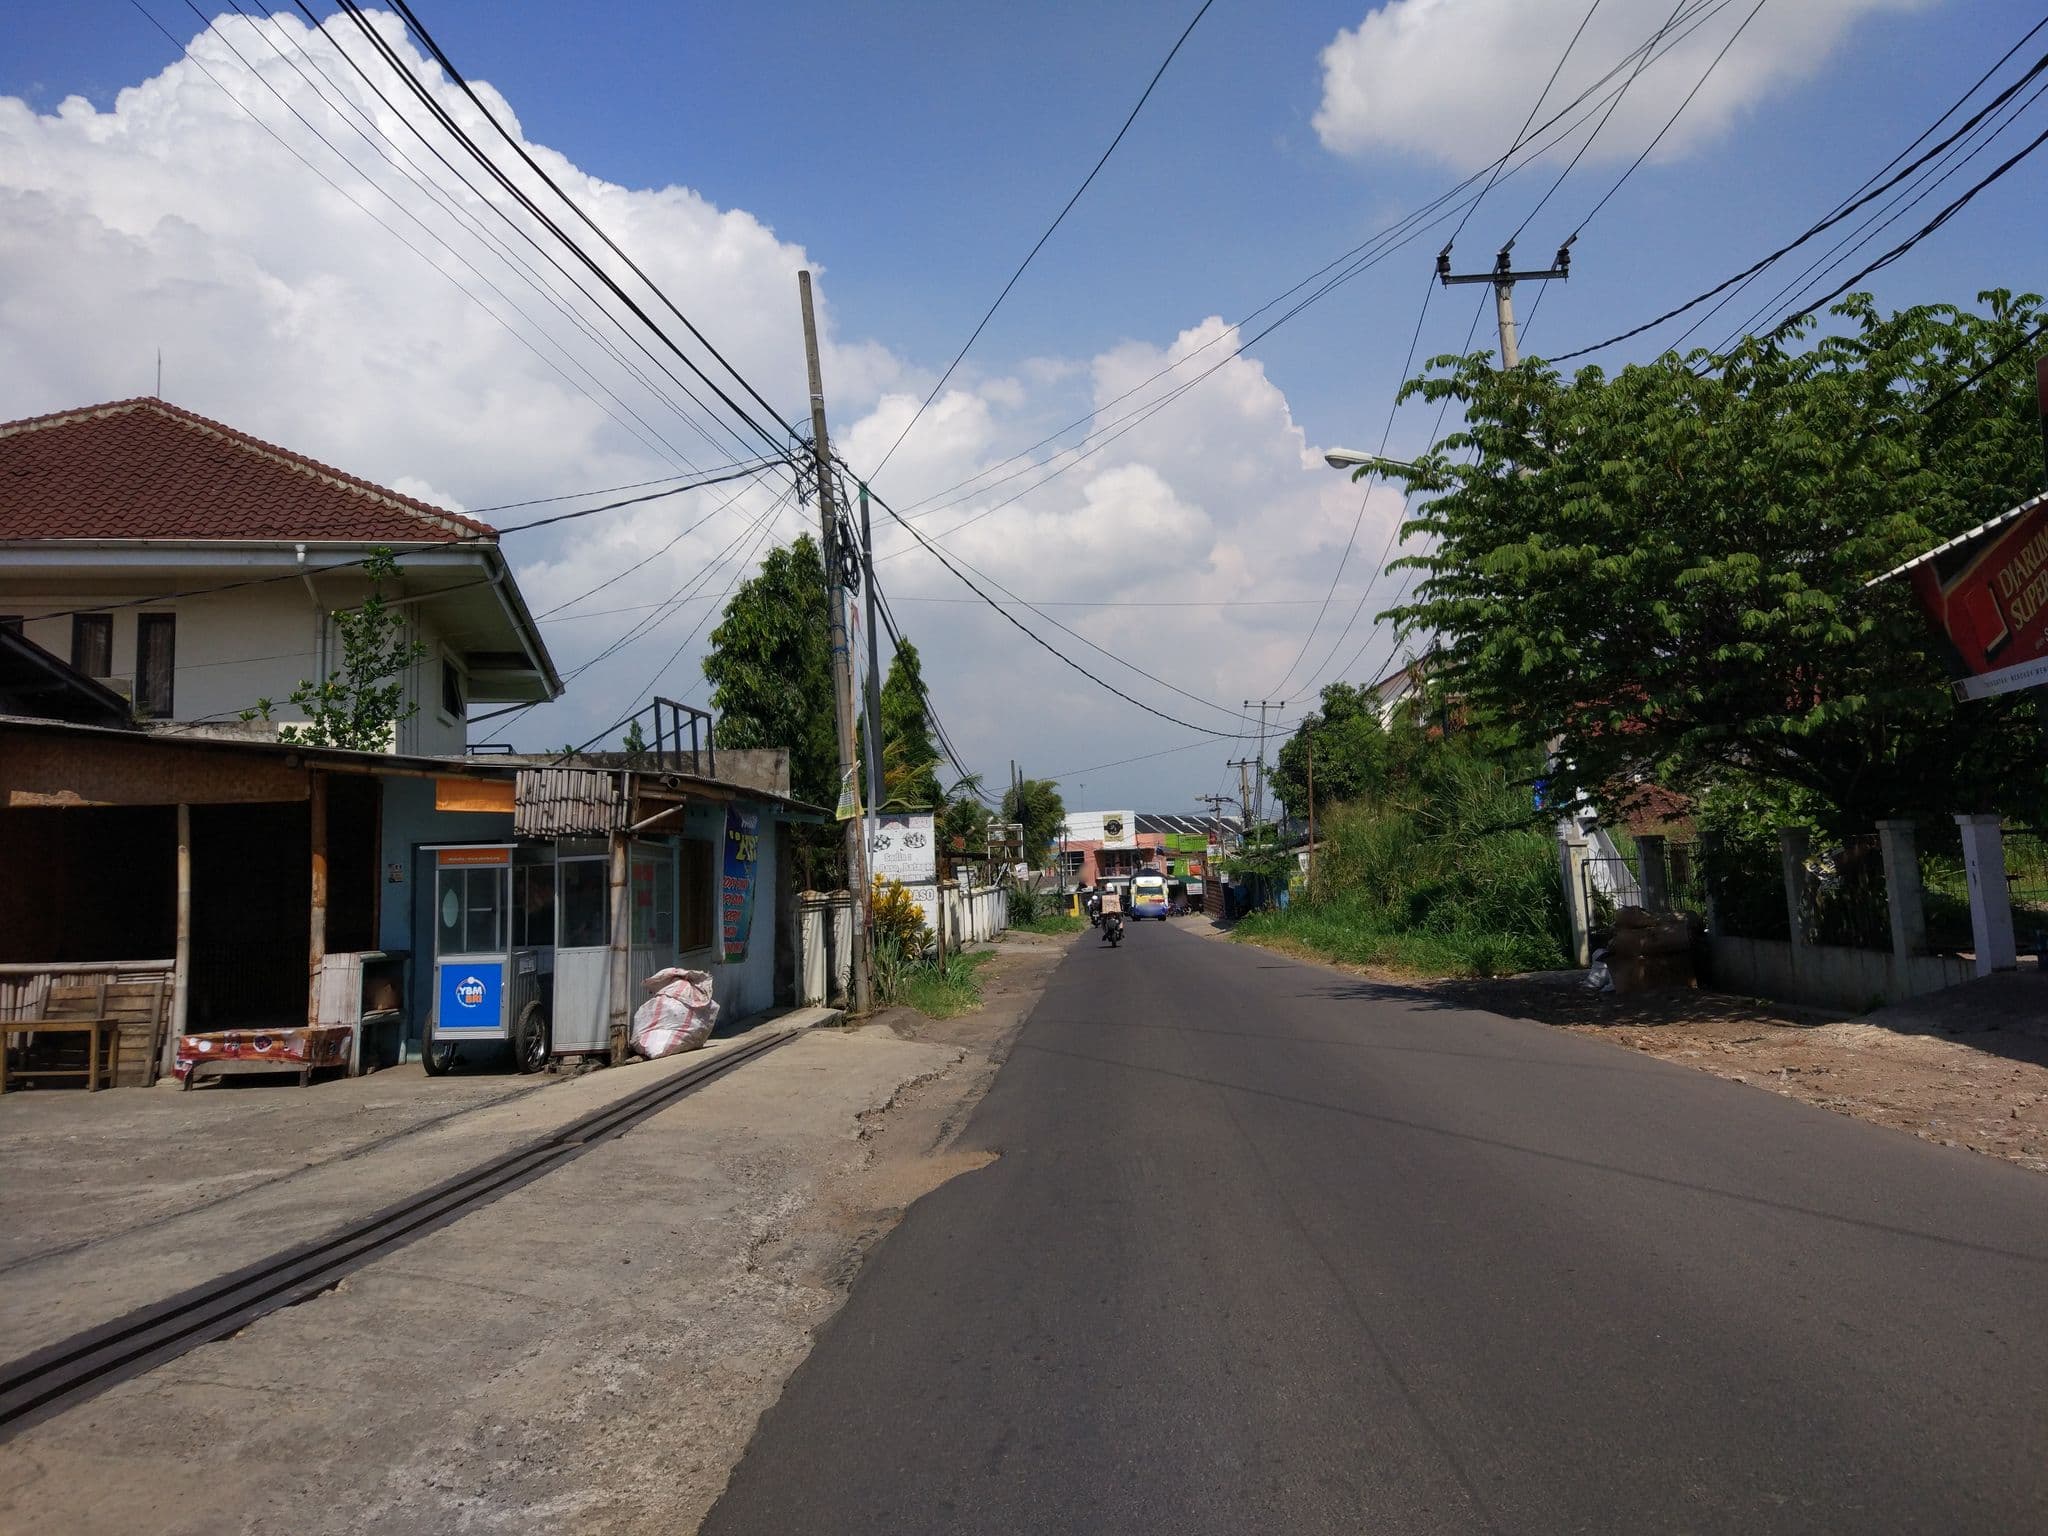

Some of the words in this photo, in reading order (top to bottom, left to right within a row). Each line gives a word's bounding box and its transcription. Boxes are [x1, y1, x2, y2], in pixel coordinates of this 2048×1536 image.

[2010, 568, 2048, 631] SUPER
[908, 889, 934, 901] ASO
[460, 986, 482, 995] YBM
